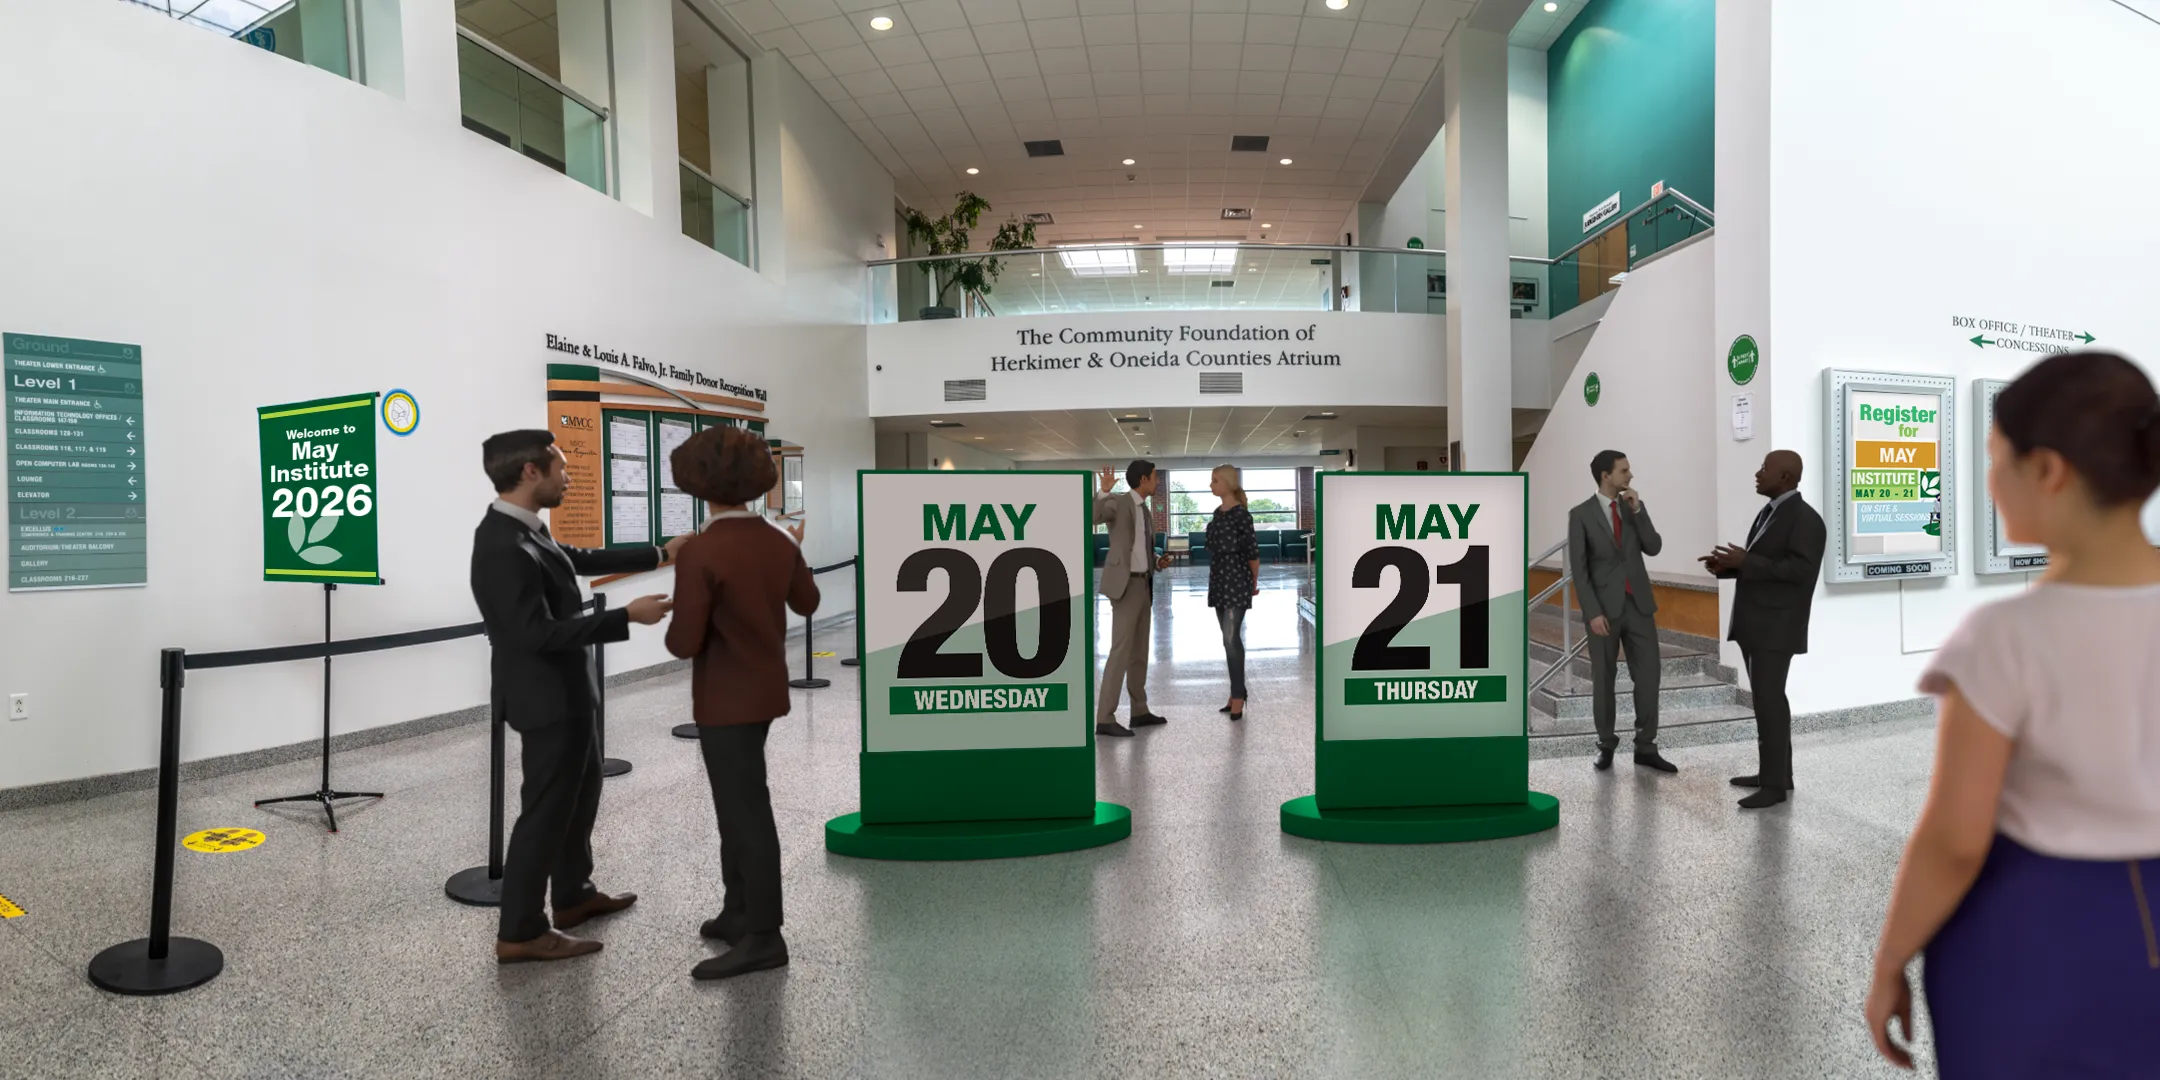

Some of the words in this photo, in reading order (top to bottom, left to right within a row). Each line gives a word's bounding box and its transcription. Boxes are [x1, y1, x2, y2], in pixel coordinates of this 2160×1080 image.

[1017, 329, 1052, 346] The
[1059, 326, 1173, 346] Community
[1180, 324, 1290, 341] Foundation
[1296, 324, 1316, 340] of
[1952, 316, 1976, 328] BOX
[1979, 319, 2018, 334] OFFICE
[2020, 324, 2026, 337] /
[2028, 325, 2074, 342] THEATER
[13, 338, 69, 354] Ground
[1996, 338, 2069, 354] CONCESSIONS
[546, 333, 580, 354] Elaine
[582, 344, 592, 357] &
[594, 345, 618, 364] Louis
[620, 352, 630, 366] A.
[632, 355, 658, 375] Falvo,
[658, 362, 668, 378] Jr.
[670, 365, 694, 385] Family
[696, 372, 718, 388] Donor
[720, 378, 754, 397] Recognition
[754, 388, 767, 402] Wall
[991, 354, 1081, 371] Herkimer
[1087, 352, 1102, 368] &
[1110, 350, 1180, 368] Oneida
[1186, 350, 1272, 366] Counties
[1276, 350, 1341, 366] Atrium
[14, 374, 60, 389] Level
[68, 378, 76, 390] 1
[57, 412, 93, 420] TECHNOLOGY
[568, 416, 594, 428] MVCC
[1860, 404, 1936, 425] Register
[15, 428, 58, 436] CLASSROOMS
[286, 428, 340, 440] Welcome
[343, 424, 356, 434] to
[1898, 424, 1918, 437] for
[292, 440, 339, 462] May
[1880, 448, 1917, 463] MAY
[270, 460, 369, 482] Institute
[1852, 472, 1916, 485] INSTITUTE
[272, 484, 372, 518] 2026
[1856, 489, 1875, 497] MAY
[1880, 489, 1890, 497] 20
[1903, 489, 1913, 497] 21
[20, 507, 60, 519] Level
[66, 507, 76, 519] 2
[1861, 504, 1872, 513] ON
[1874, 504, 1890, 512] SITE
[1892, 504, 1898, 512] &
[923, 504, 1037, 541] MAY
[1376, 504, 1480, 540] MAY
[1862, 513, 1892, 522] VIRTUAL
[1895, 512, 1930, 521] SESSIONS
[1868, 566, 1902, 574] COMING
[1906, 564, 1930, 572] SOON
[21, 575, 62, 583] CLASSROOMS
[896, 547, 1071, 679] 20
[1352, 545, 1490, 671] 21
[1374, 680, 1478, 700] THURSDAY
[914, 688, 1049, 711] WEDNESDAY
